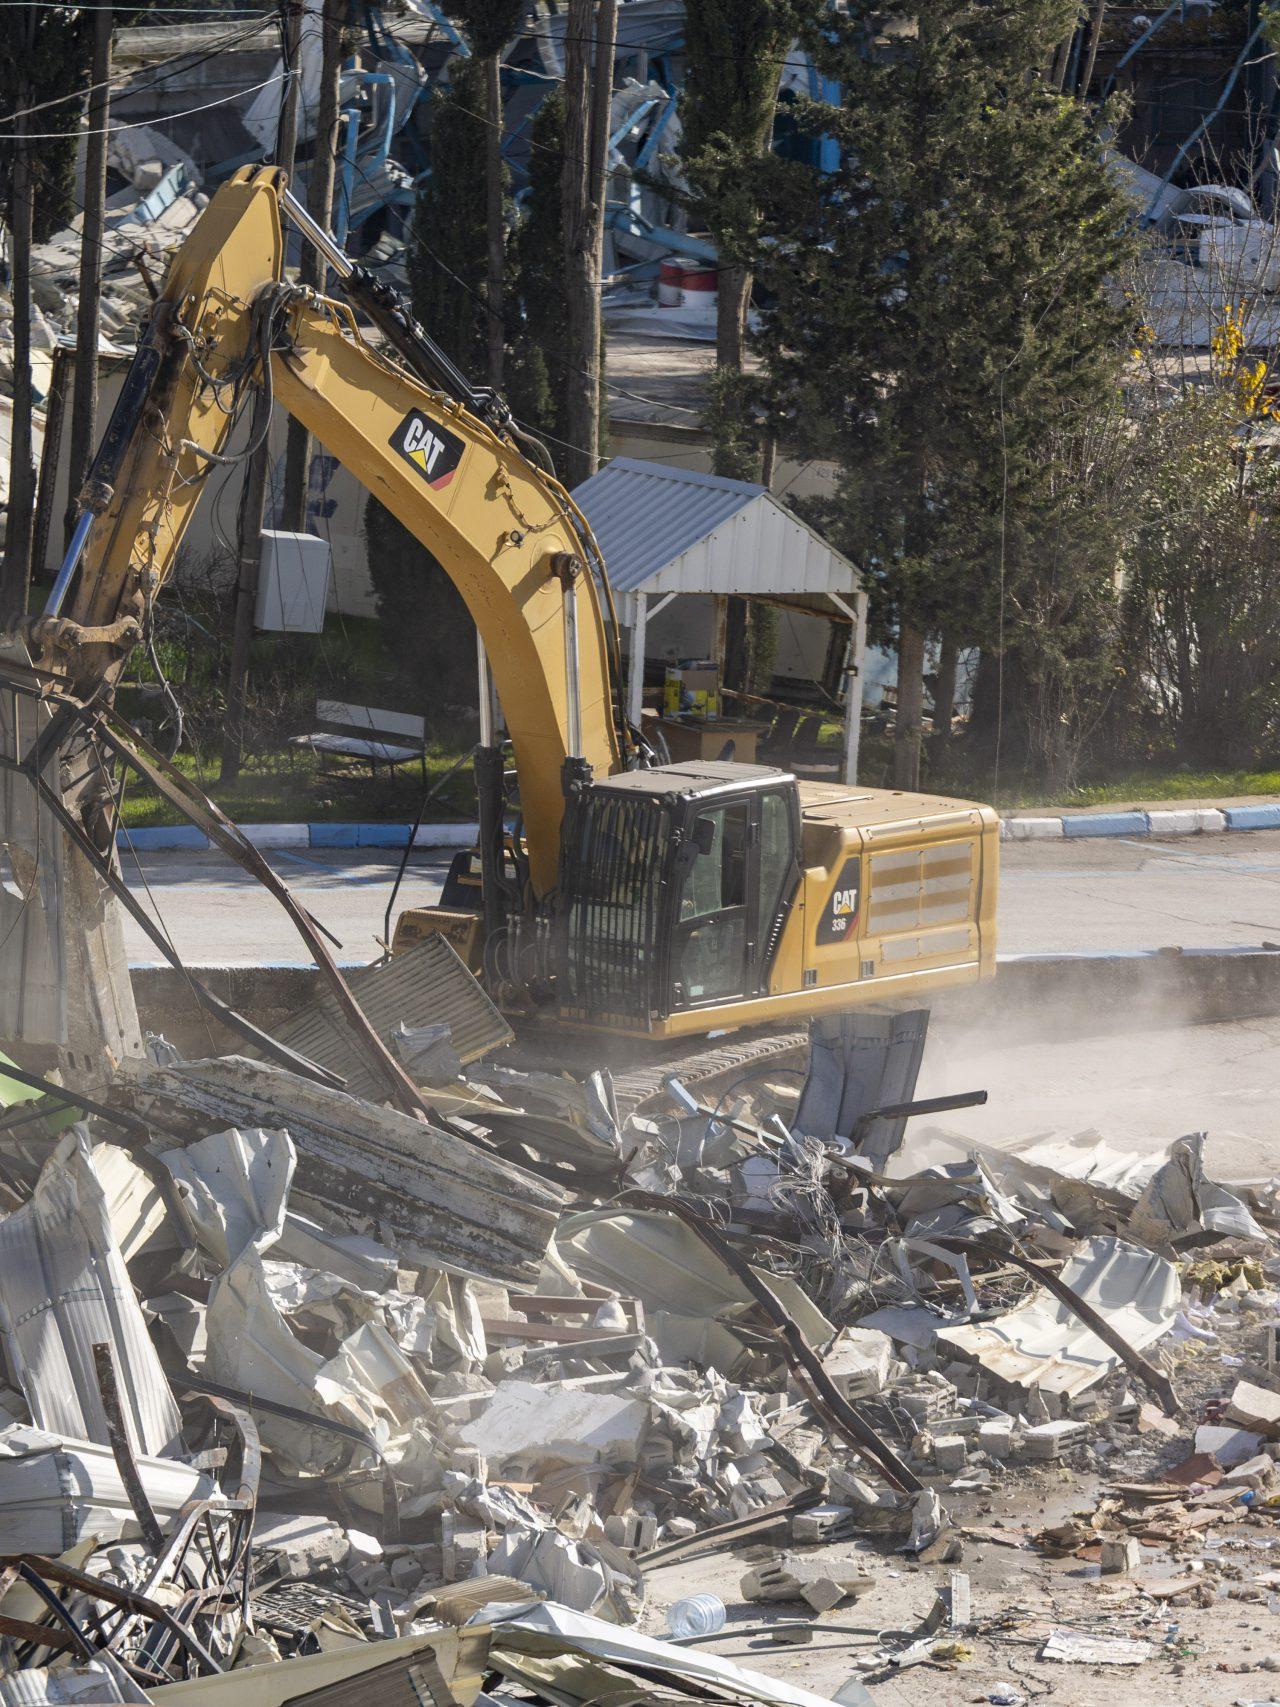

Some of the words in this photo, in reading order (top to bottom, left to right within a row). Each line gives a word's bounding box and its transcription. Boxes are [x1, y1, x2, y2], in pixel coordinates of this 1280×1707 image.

[403, 417, 446, 475] CAT
[833, 889, 857, 915] CAT
[832, 918, 847, 931] 336
